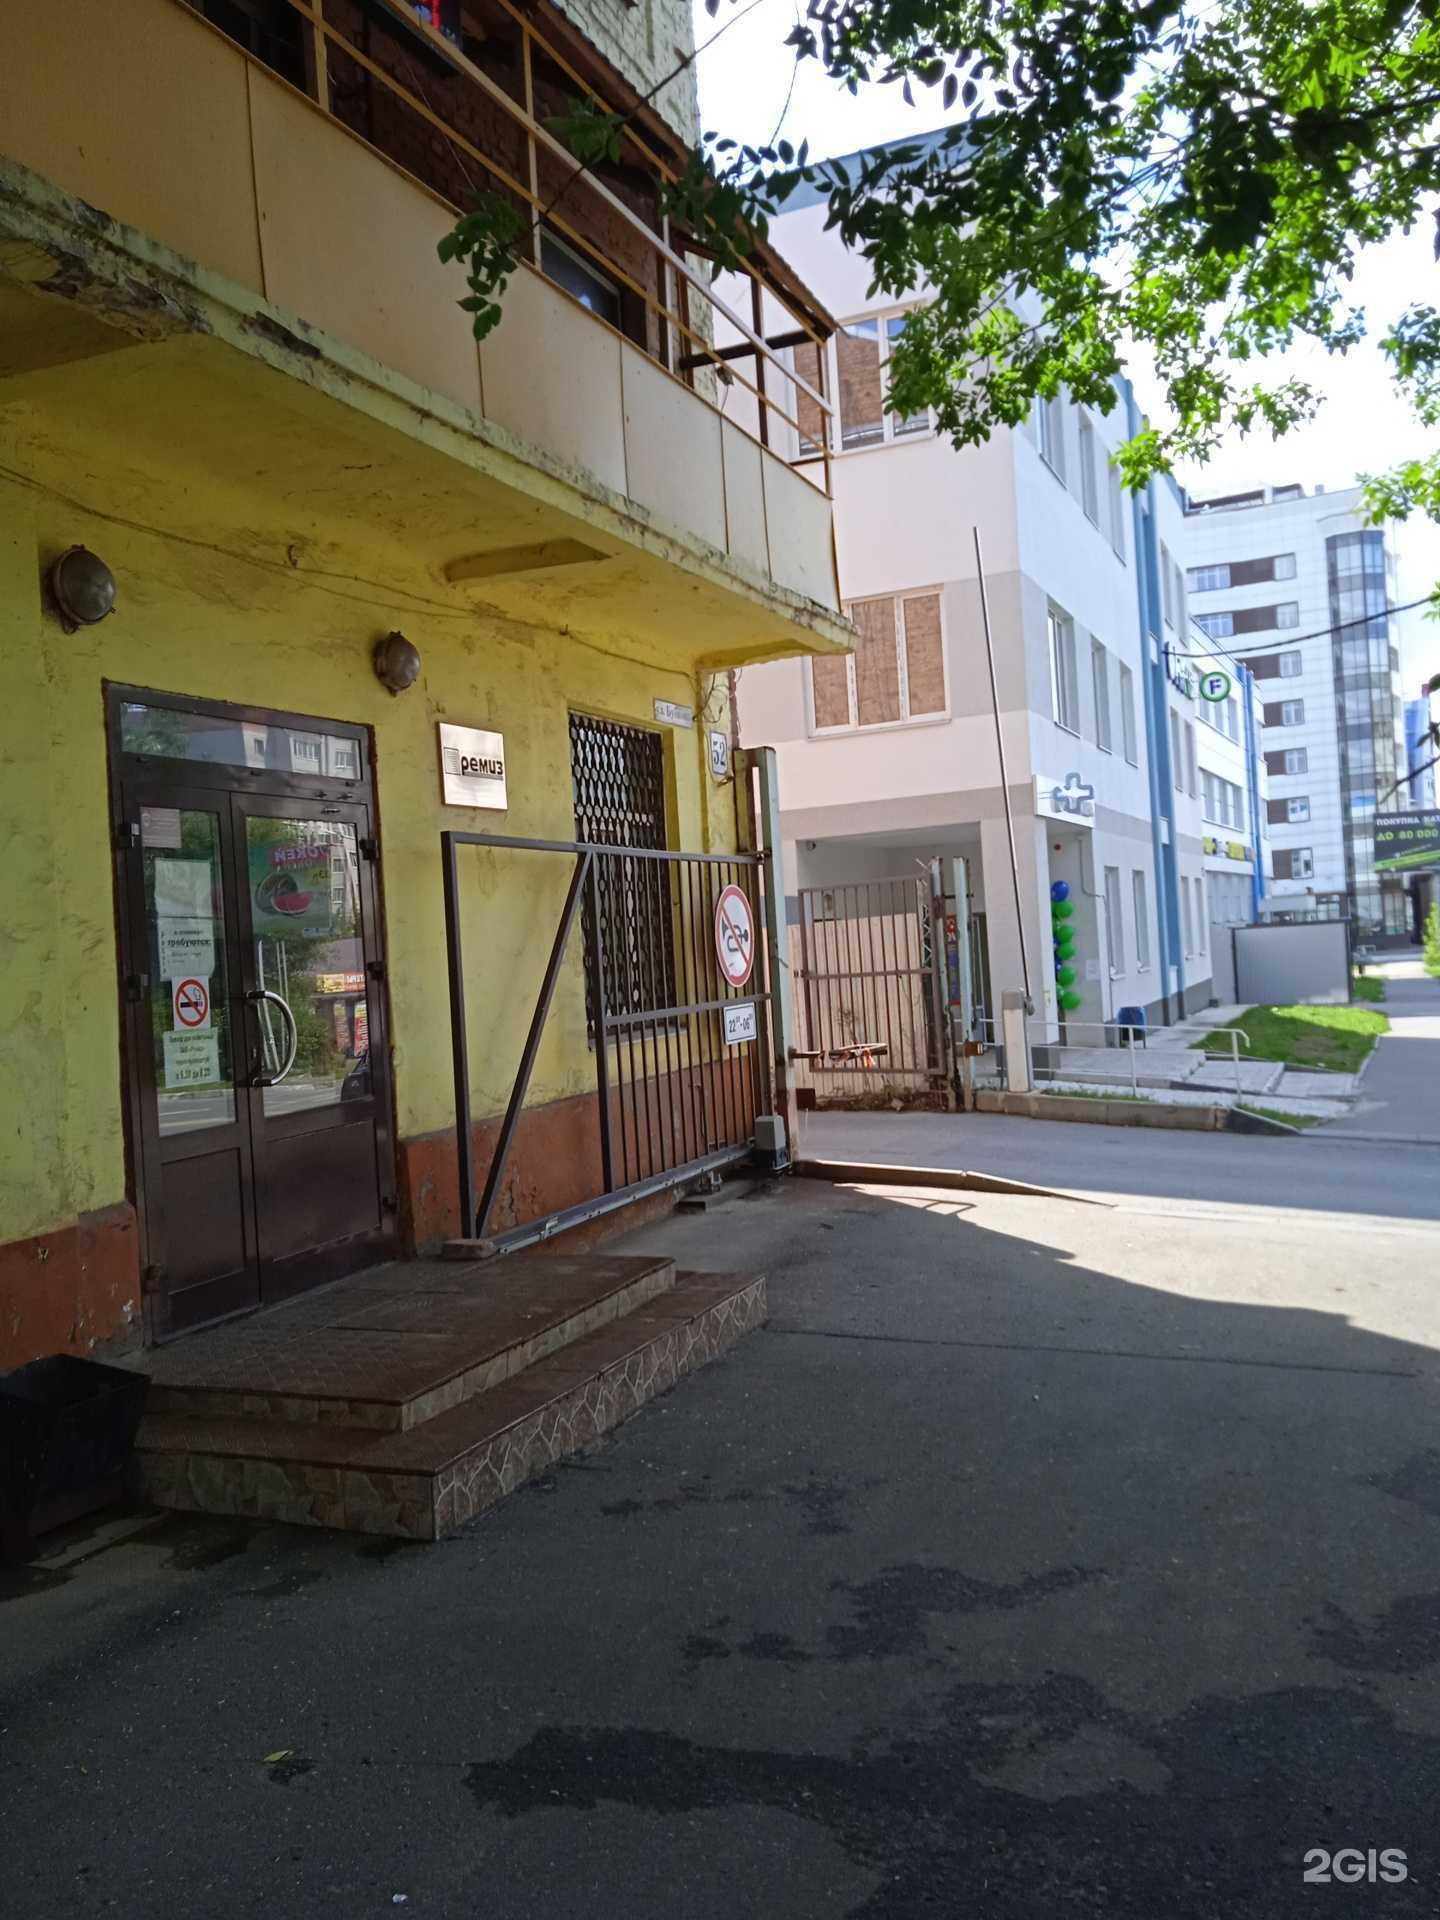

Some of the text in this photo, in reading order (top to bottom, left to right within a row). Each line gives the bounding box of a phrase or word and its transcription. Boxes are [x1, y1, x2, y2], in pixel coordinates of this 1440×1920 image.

[712, 741, 725, 767] 52
[461, 756, 503, 776] ремиз
[1376, 816, 1420, 825] ПОКУПКА
[1376, 832, 1394, 841] ДО
